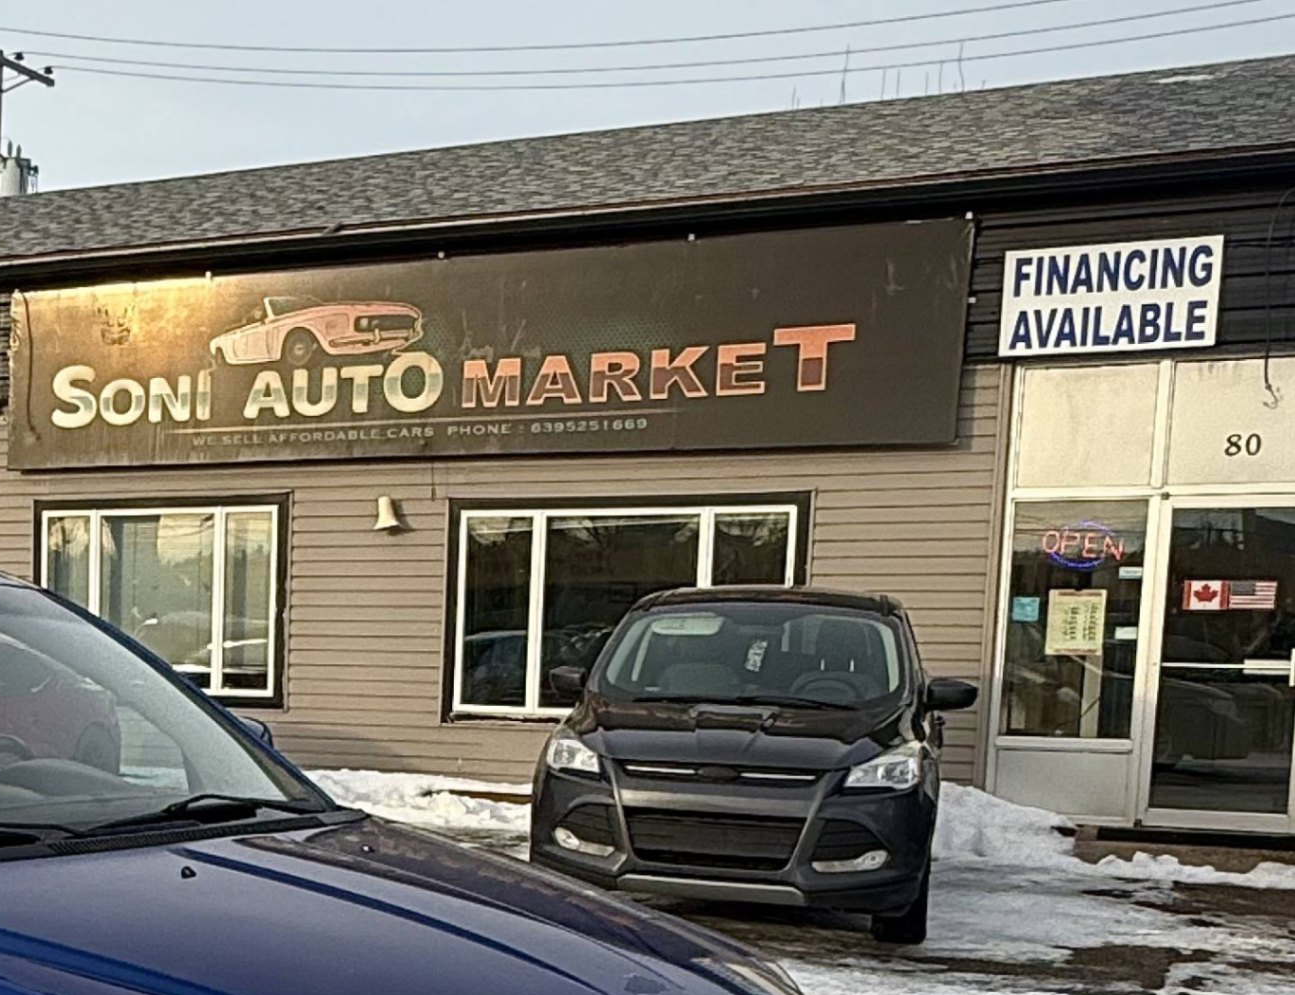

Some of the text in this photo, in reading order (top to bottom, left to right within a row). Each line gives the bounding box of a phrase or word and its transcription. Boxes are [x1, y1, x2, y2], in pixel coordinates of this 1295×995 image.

[1013, 245, 1213, 297] FINANCING
[1008, 300, 1208, 350] AVAILABLE
[51, 323, 856, 428] SONI AUTO MARKET
[193, 435, 216, 446] WE
[222, 434, 262, 446] SELL
[268, 429, 384, 444] AFFORDABLE
[387, 426, 434, 438] CARS
[447, 423, 512, 436] PHONE
[1224, 433, 1261, 456] 80
[1041, 530, 1124, 560] OPEN
